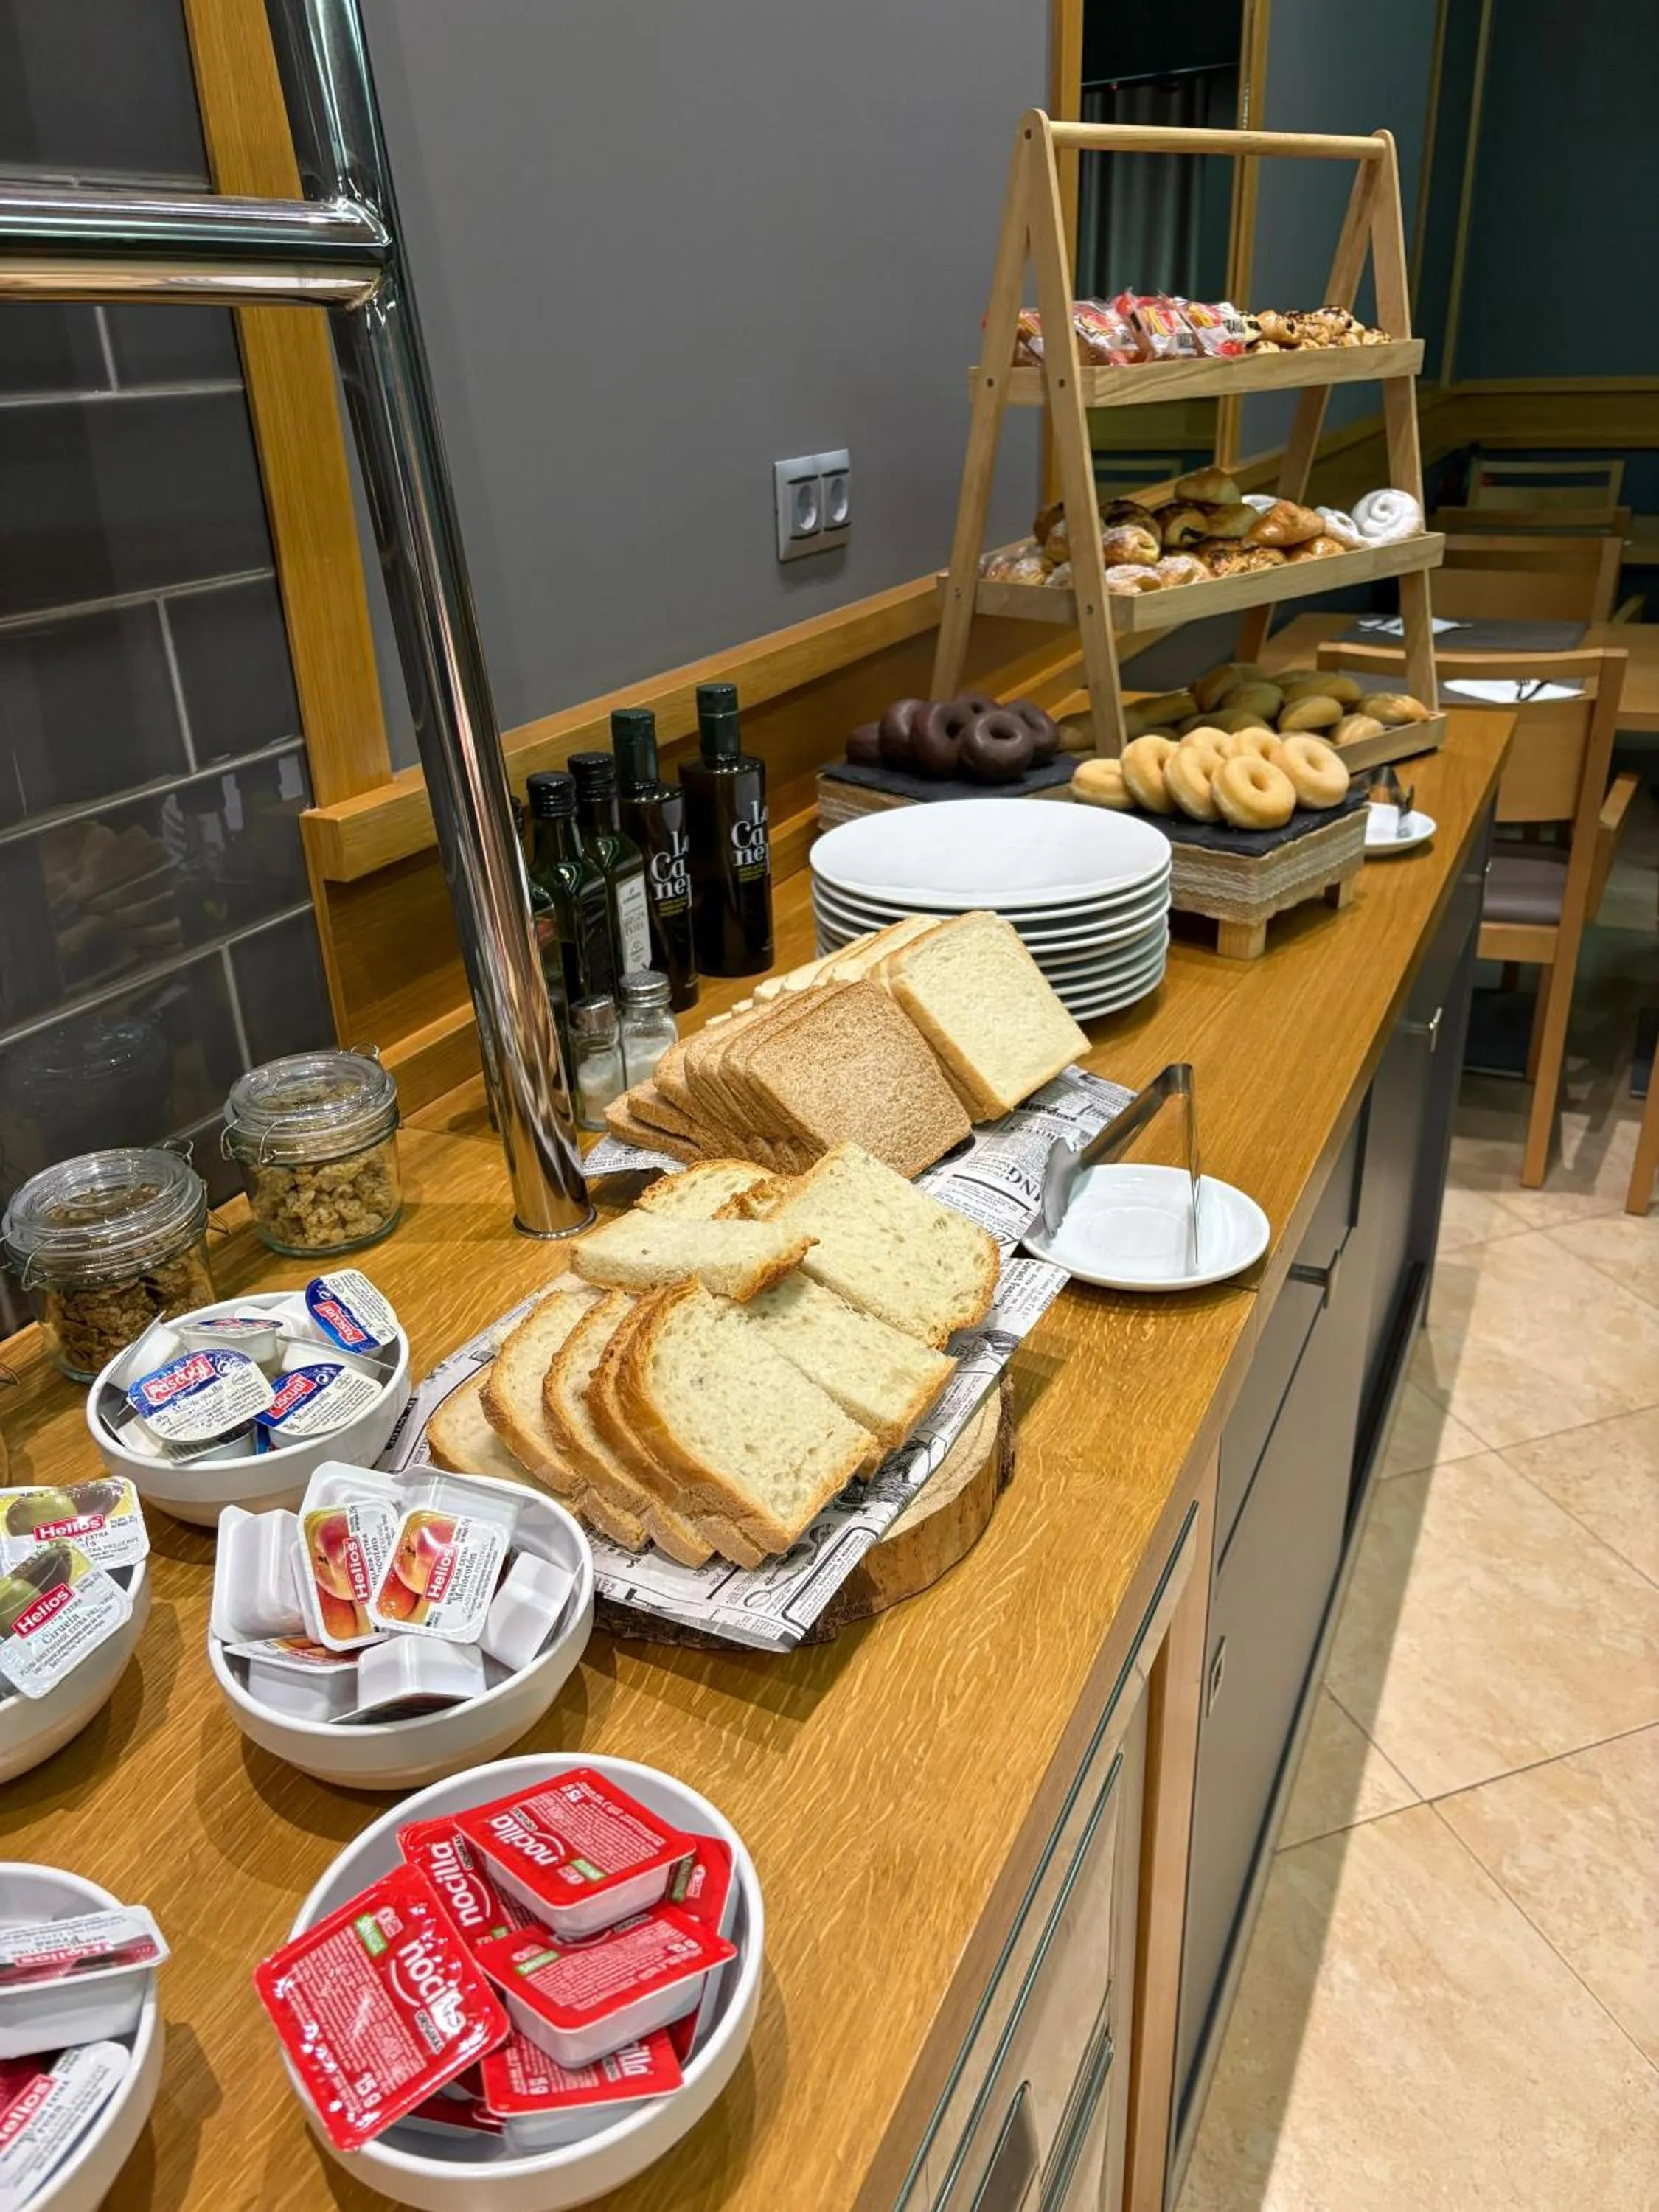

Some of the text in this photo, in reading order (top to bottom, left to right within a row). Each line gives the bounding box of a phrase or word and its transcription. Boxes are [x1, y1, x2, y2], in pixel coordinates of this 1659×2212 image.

[731, 820, 765, 849] Ca
[650, 852, 686, 882] Ca
[320, 1304, 358, 1341] Pascual
[147, 1361, 209, 1400] Pascual
[272, 1379, 307, 1410] ascual
[39, 1516, 102, 1539] Helios
[349, 1541, 369, 1599] Helios
[427, 1548, 455, 1599] Helios
[16, 1589, 69, 1635] Helios
[41, 1613, 80, 1645] Ciruela
[490, 1815, 558, 1866] nocilla
[431, 1841, 484, 1927] nocilla
[616, 2038, 655, 2078] illa
[354, 2071, 378, 2096] 15
[0, 2081, 50, 2141] elios
